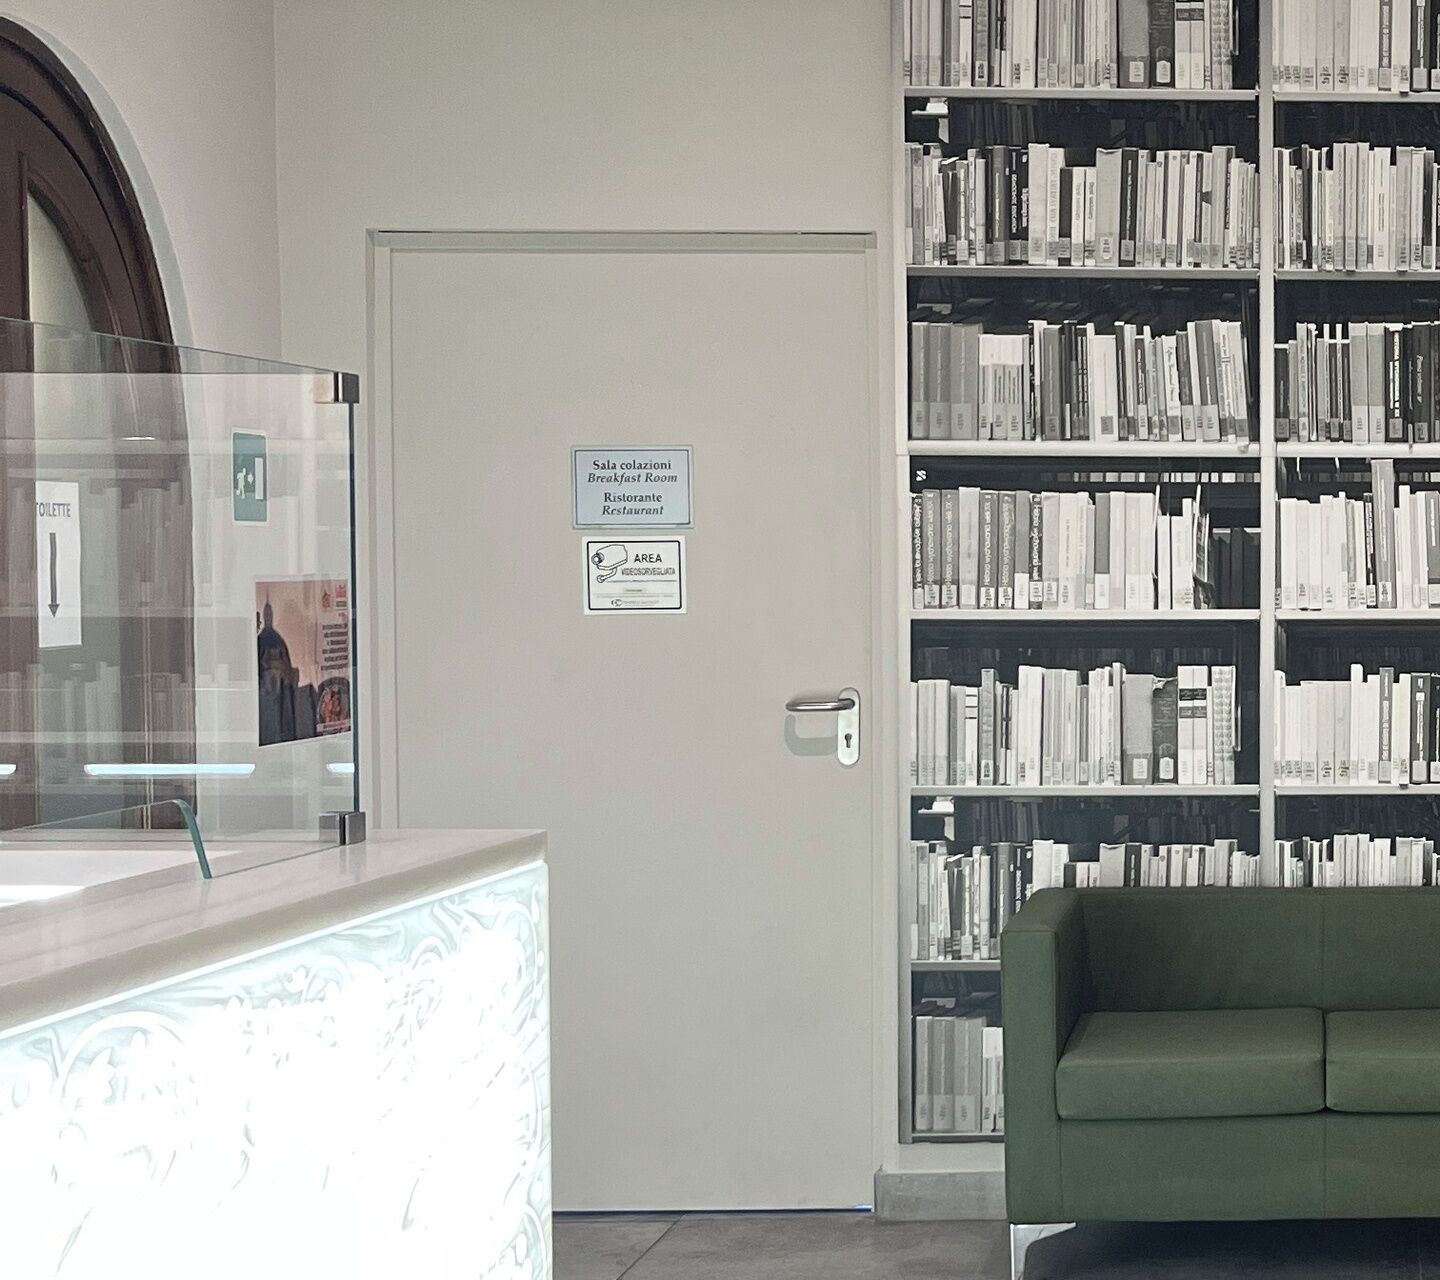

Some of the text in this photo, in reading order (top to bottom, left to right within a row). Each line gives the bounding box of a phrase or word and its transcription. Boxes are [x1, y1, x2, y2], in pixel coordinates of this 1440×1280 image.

[592, 459, 672, 471] Sala colazioni
[587, 472, 678, 486] Breakfast Room
[603, 492, 663, 503] Ristorante
[601, 505, 664, 516] Restaurant
[633, 553, 663, 563] AREA
[621, 567, 676, 576] VIDEOSORVEGLIATA
